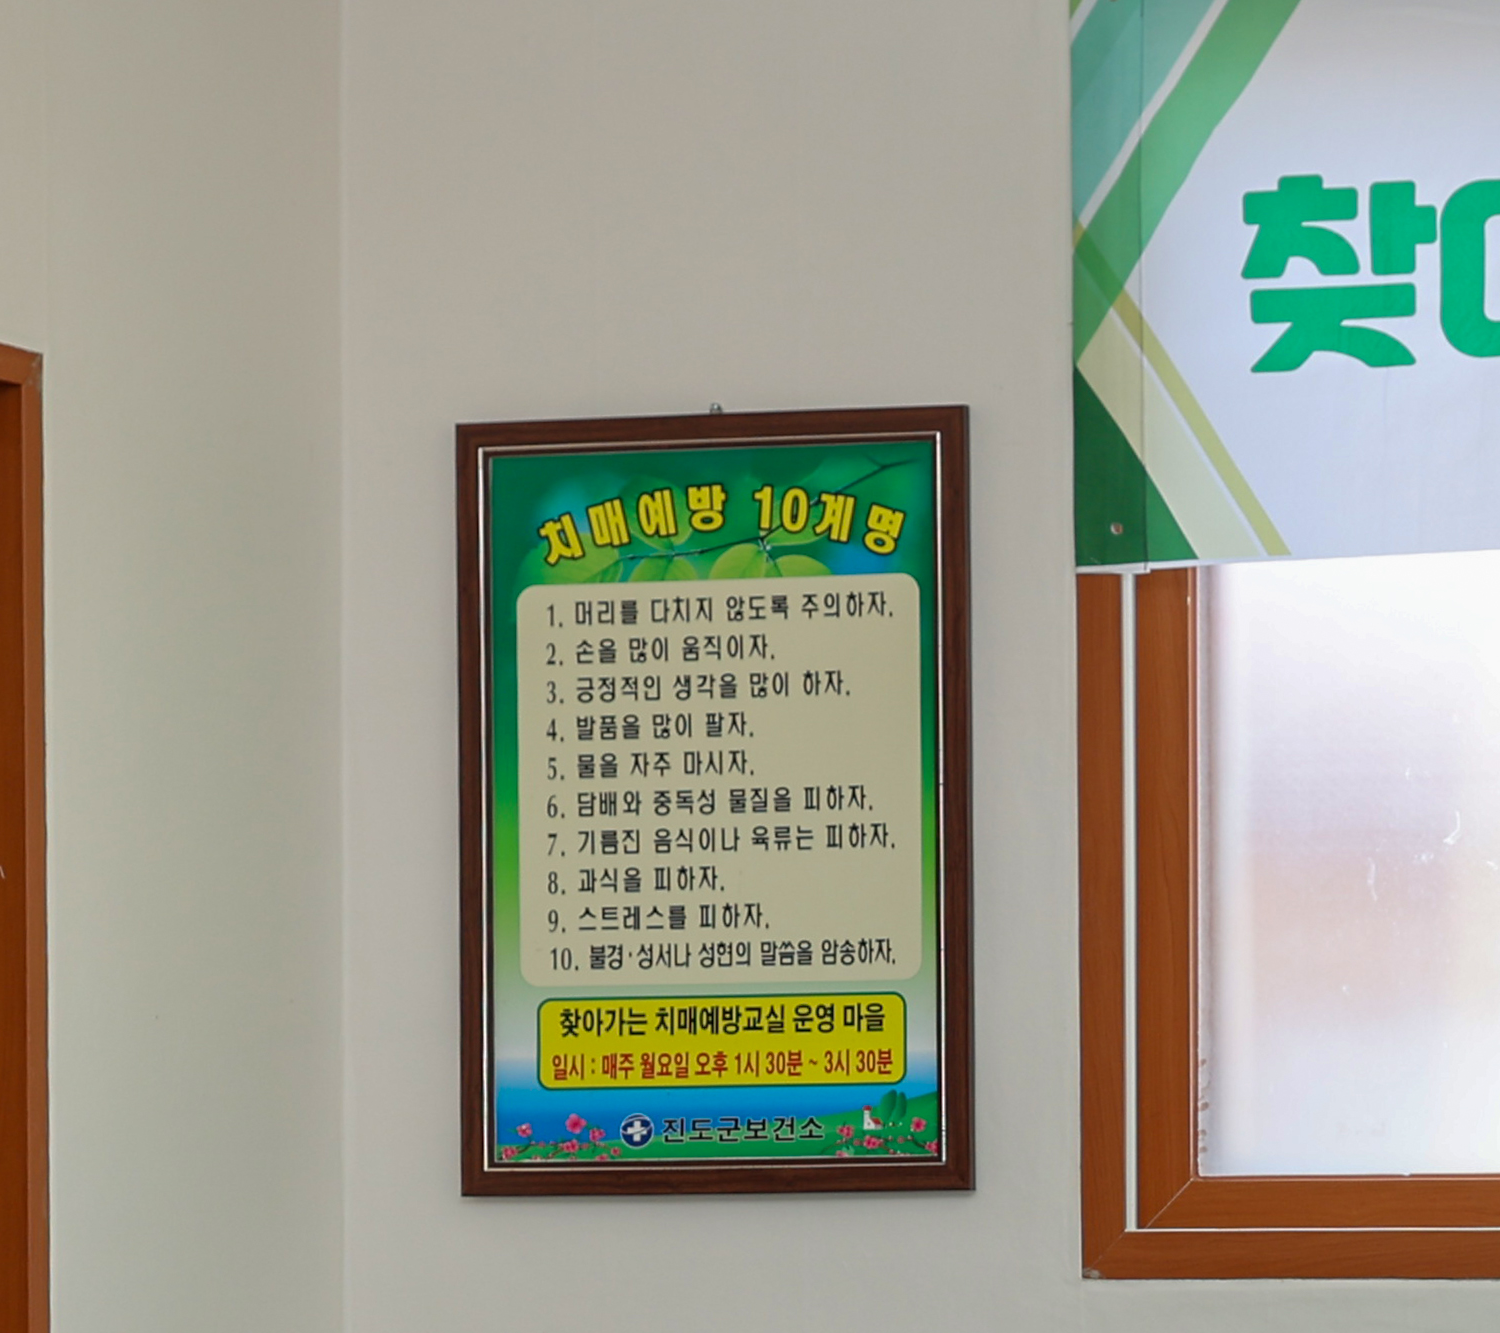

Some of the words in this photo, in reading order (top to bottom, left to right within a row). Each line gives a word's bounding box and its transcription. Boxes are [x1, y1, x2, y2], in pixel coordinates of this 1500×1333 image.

[538, 484, 727, 567] 치매예방
[753, 484, 906, 555] 10계명
[546, 604, 563, 628] 1.
[575, 599, 639, 626] 머리를
[651, 596, 713, 623] 다치지
[726, 594, 789, 622] 않도록
[801, 591, 894, 619] 주의하자.
[546, 642, 563, 666] 2.
[576, 638, 618, 664] 손을
[629, 636, 669, 663] 많이
[682, 633, 776, 661] 움직이자.
[546, 681, 564, 704] 3.
[576, 675, 662, 703] 긍정적인
[673, 673, 738, 701] 생각을
[750, 671, 789, 698] 많이
[803, 669, 851, 696] 하자.
[546, 719, 564, 742] 4.
[576, 714, 641, 741] 발품을
[652, 712, 692, 739] 많이
[705, 711, 754, 738] 팔자.
[547, 757, 564, 781] 5.
[576, 752, 618, 779] 물을
[630, 752, 672, 778] 자주
[684, 750, 754, 776] 마시자.
[546, 794, 565, 819] 6.
[577, 790, 642, 817] 담배와
[653, 789, 717, 815] 중독성
[728, 787, 792, 814] 물질을
[804, 785, 874, 811] 피하자.
[547, 833, 566, 857] 7.
[578, 829, 641, 856] 기름진
[653, 826, 741, 853] 음식이나
[751, 824, 815, 851] 육류는
[825, 822, 896, 849] 피하자.
[547, 871, 566, 895] 8.
[578, 867, 642, 894] 과식을
[654, 865, 725, 892] 피하자.
[548, 909, 566, 933] 9.
[578, 905, 686, 931] 스트레스를
[699, 902, 770, 929] 피하자.
[549, 948, 579, 971] 10.
[699, 941, 752, 968] 성현의
[760, 939, 813, 967] 말씀을
[821, 938, 896, 966] 암송하자.
[559, 1007, 648, 1038] 찾아가는
[655, 1004, 786, 1036] 치매예방교실
[792, 1004, 836, 1032] 운영
[843, 1002, 886, 1032] 마을
[552, 1054, 586, 1081] 일시
[602, 1052, 634, 1080] 매주
[641, 1052, 690, 1078] 월요일
[695, 1051, 728, 1077] 오후
[735, 1051, 760, 1076] 1시
[766, 1050, 803, 1076] 30분
[824, 1049, 851, 1076] 3시
[856, 1048, 893, 1075] 30분
[662, 1116, 824, 1143] 진도군보건소
